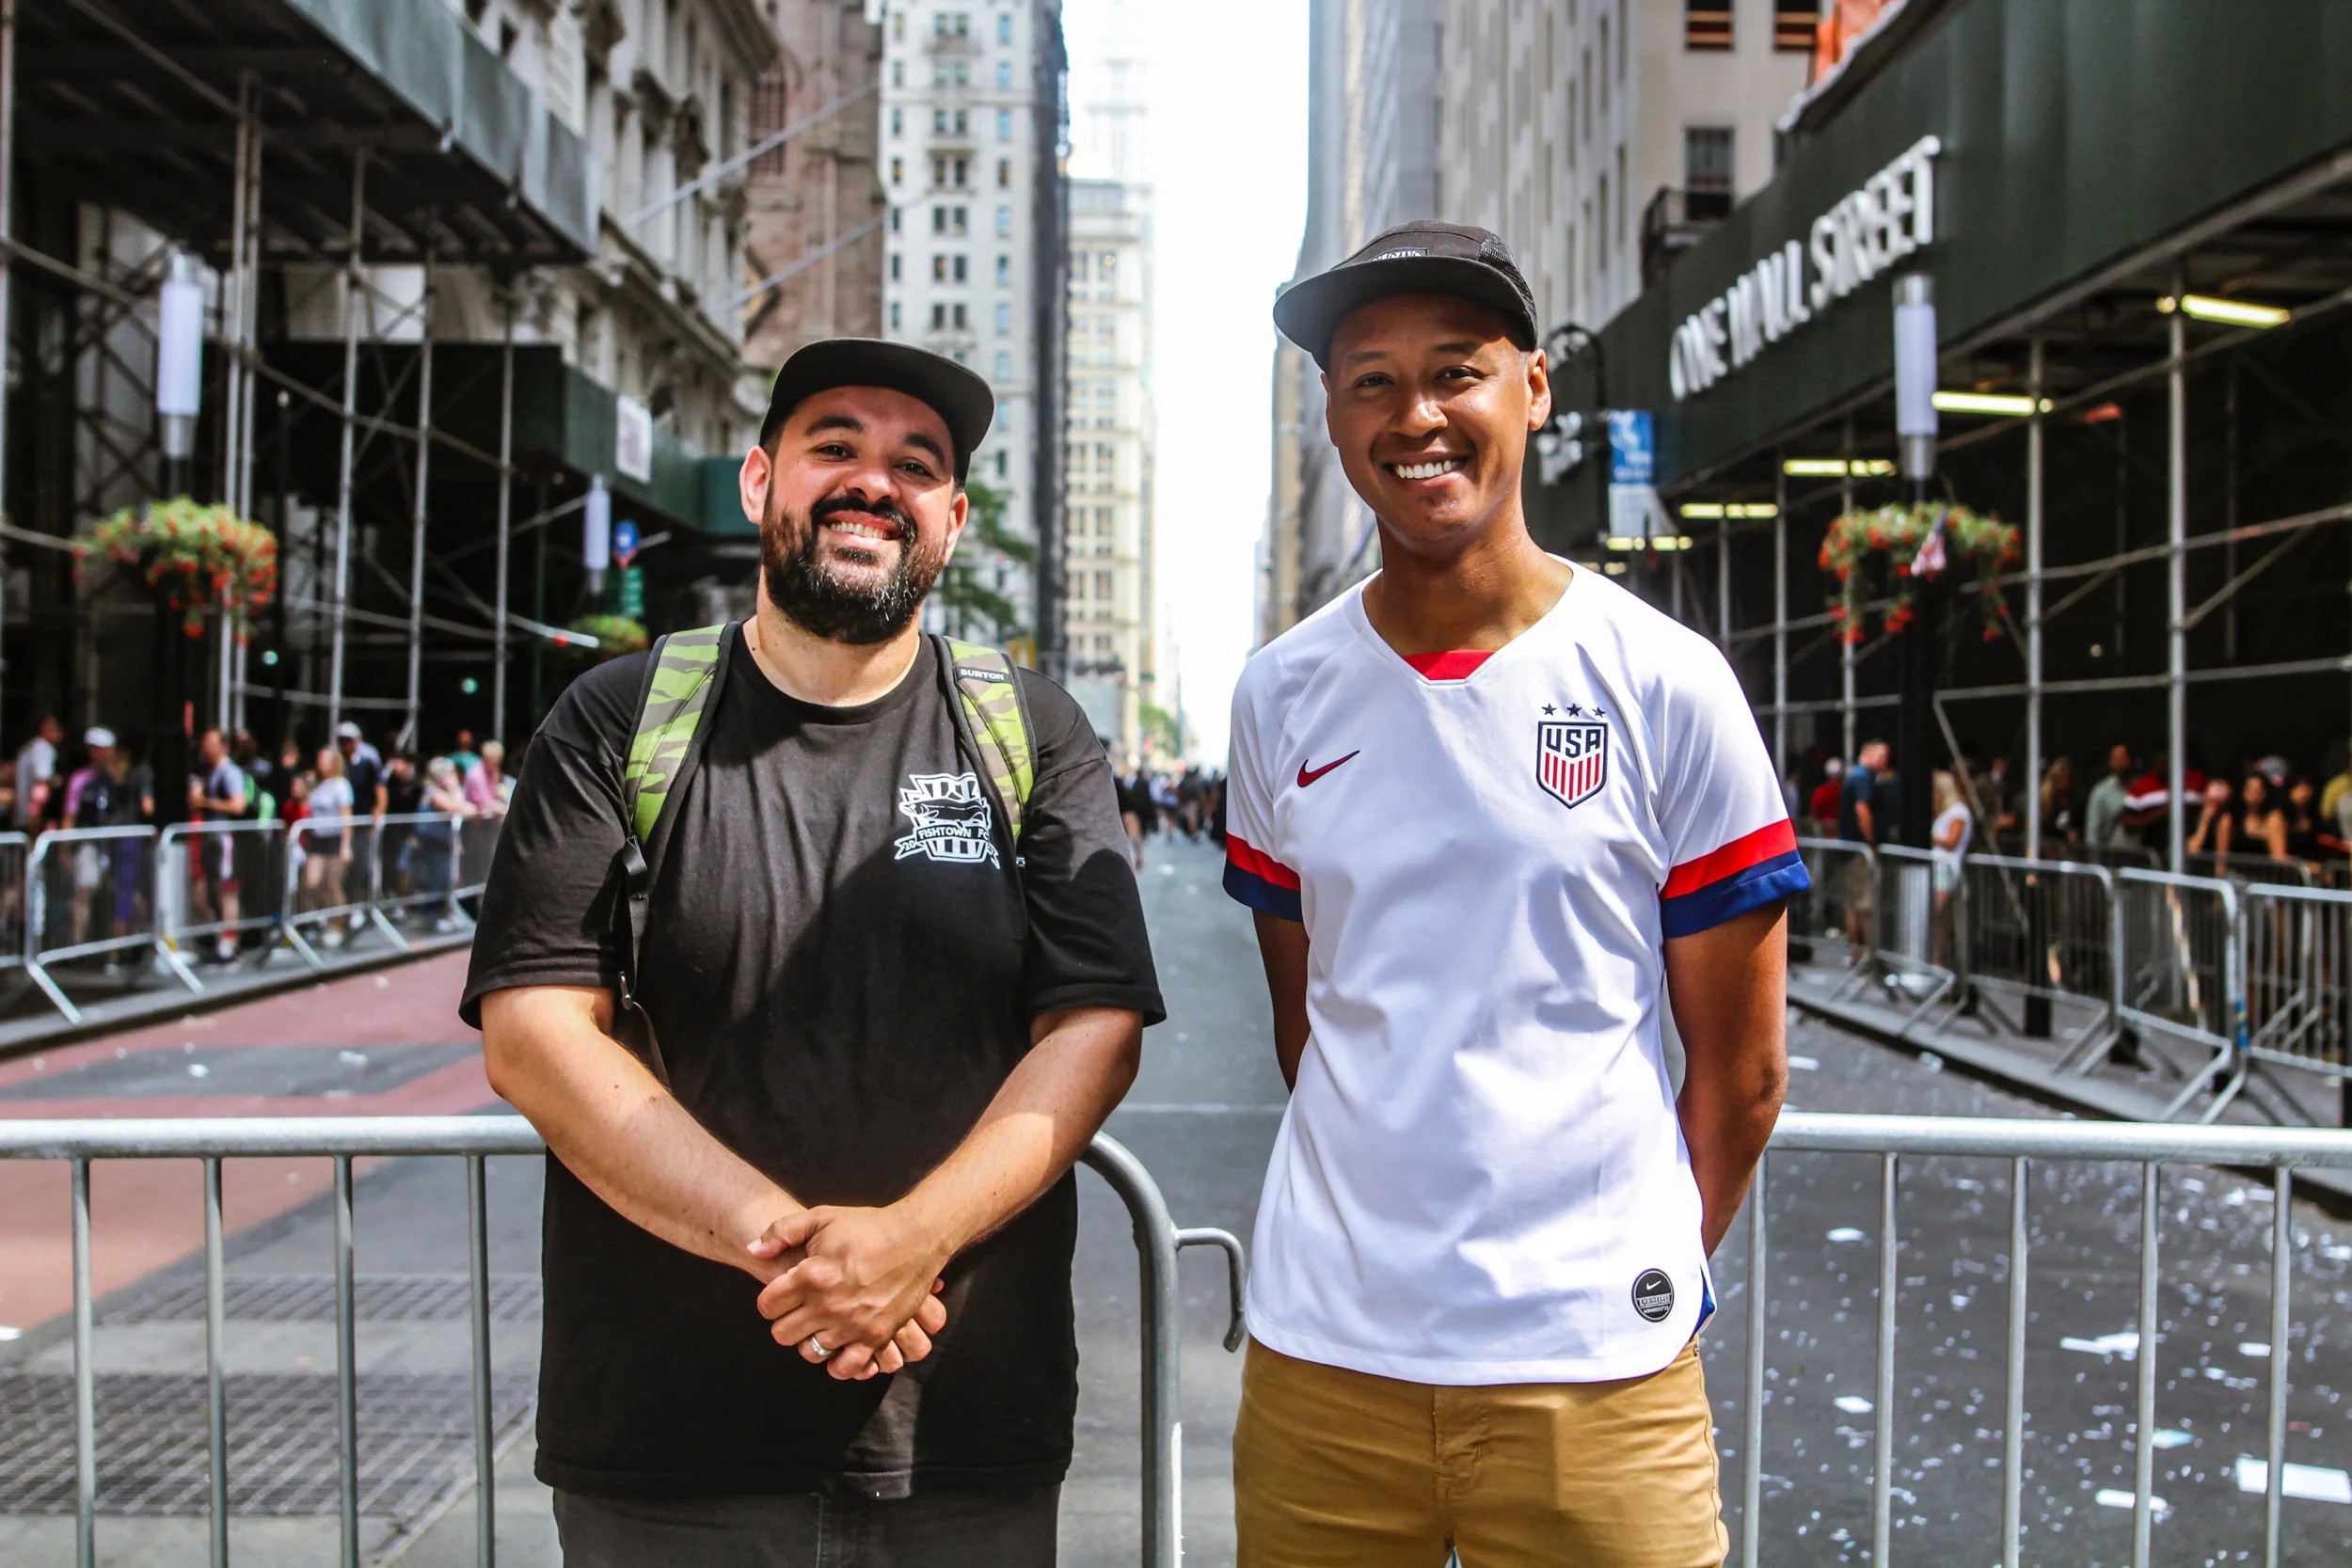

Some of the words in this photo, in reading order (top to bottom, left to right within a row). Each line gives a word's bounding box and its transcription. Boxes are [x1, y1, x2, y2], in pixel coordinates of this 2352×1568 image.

[1810, 135, 1941, 312] STREET
[961, 669, 1005, 681] BURTON
[1546, 728, 1601, 759] USA
[917, 827, 973, 840] FISHTOWN
